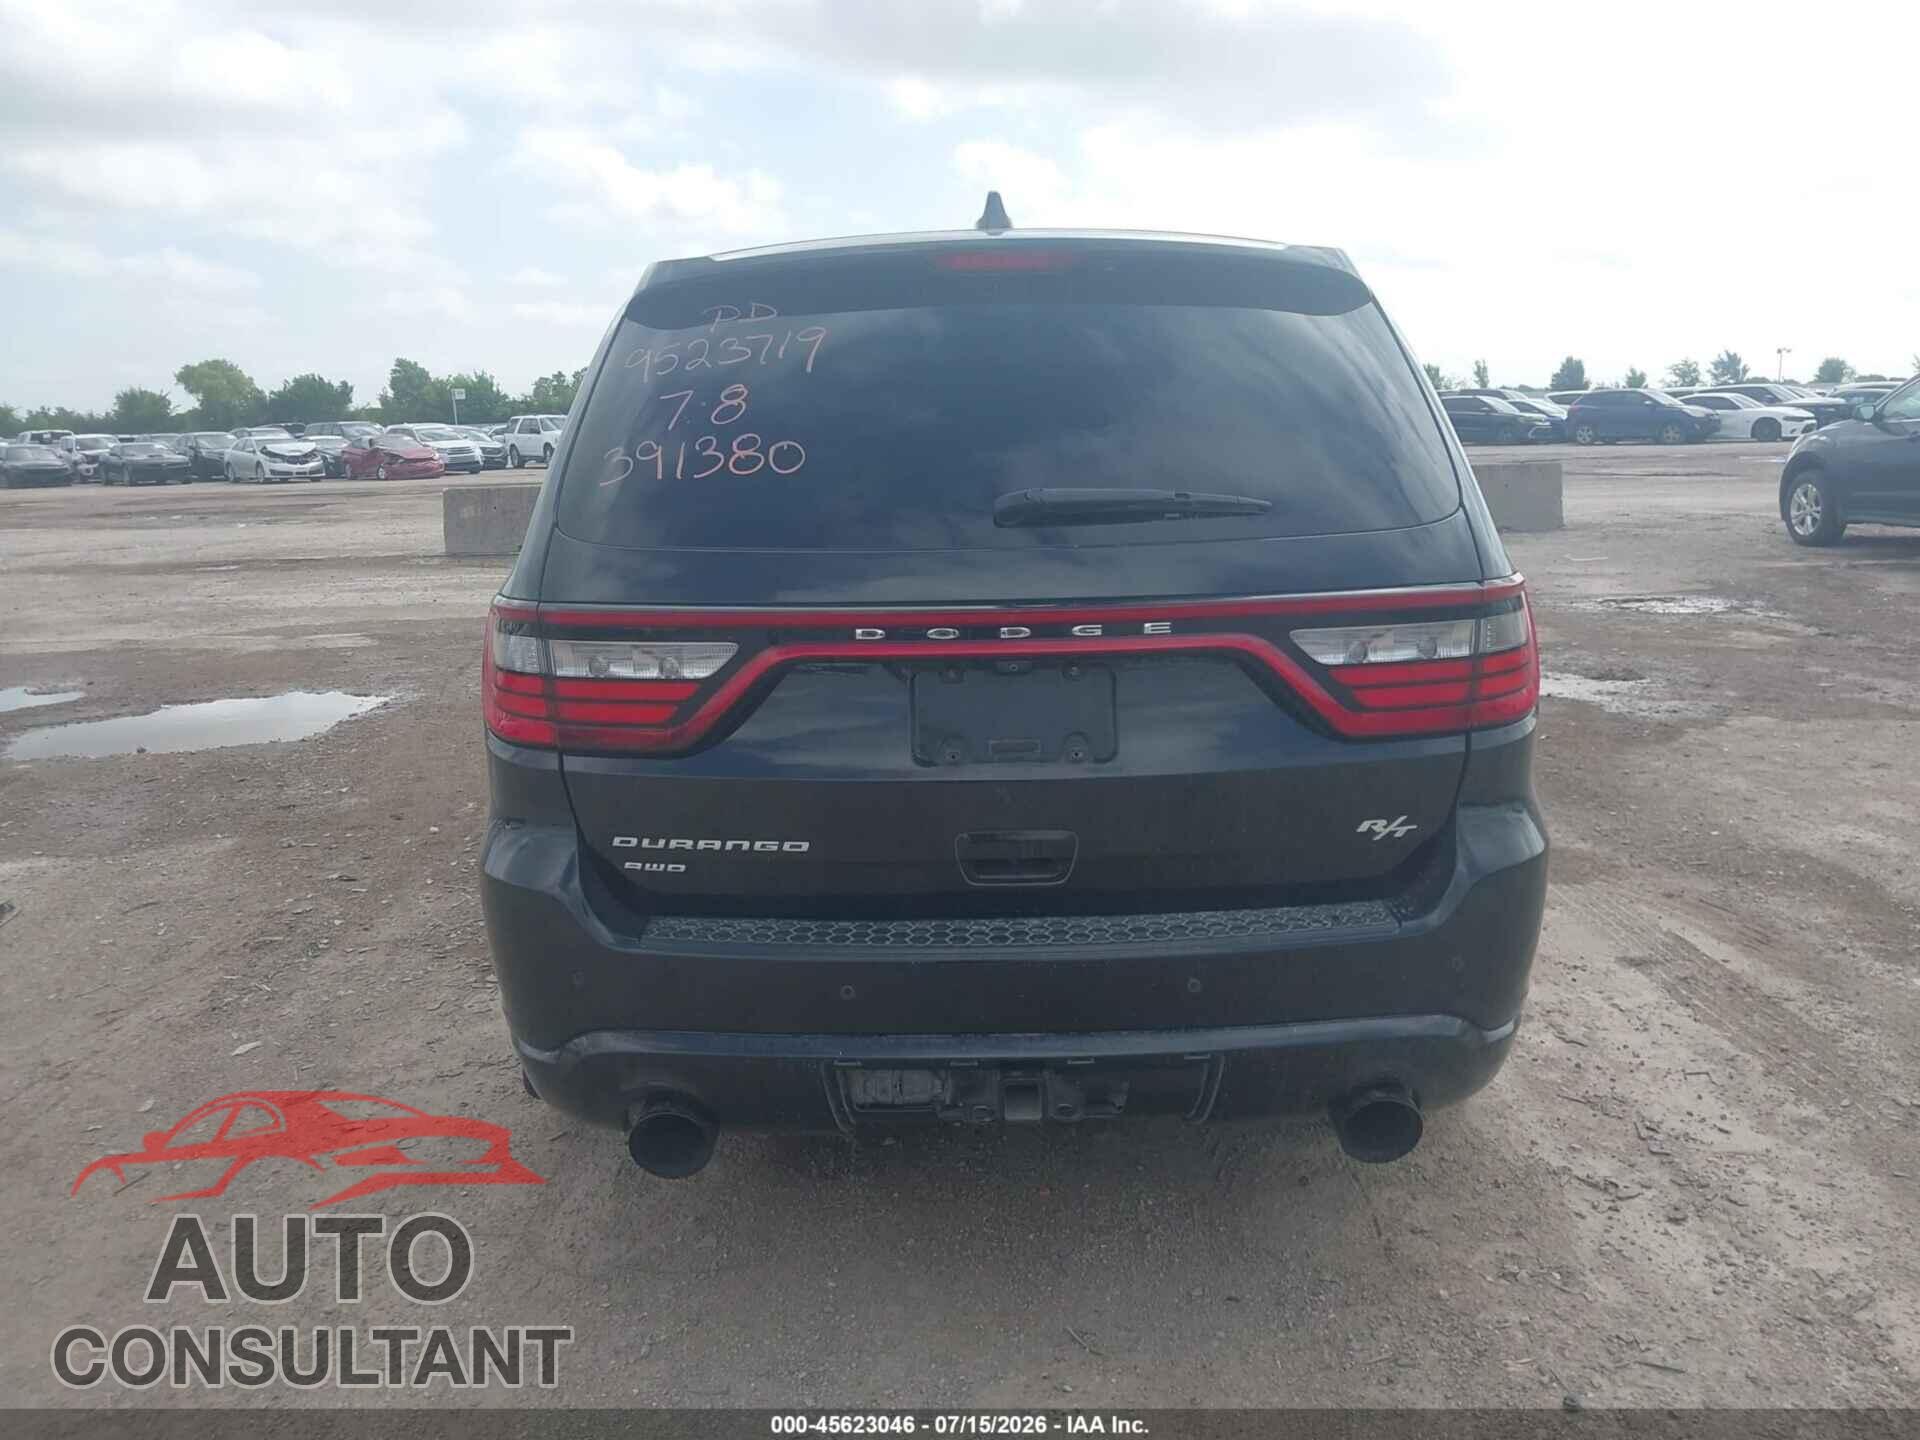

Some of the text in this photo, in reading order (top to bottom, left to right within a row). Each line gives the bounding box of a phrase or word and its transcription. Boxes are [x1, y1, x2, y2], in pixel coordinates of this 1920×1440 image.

[624, 326, 826, 383] 9523719
[599, 433, 806, 487] 391380
[855, 622, 1172, 640] DODGE
[612, 836, 810, 852] DURANGO
[624, 861, 687, 872] AWD
